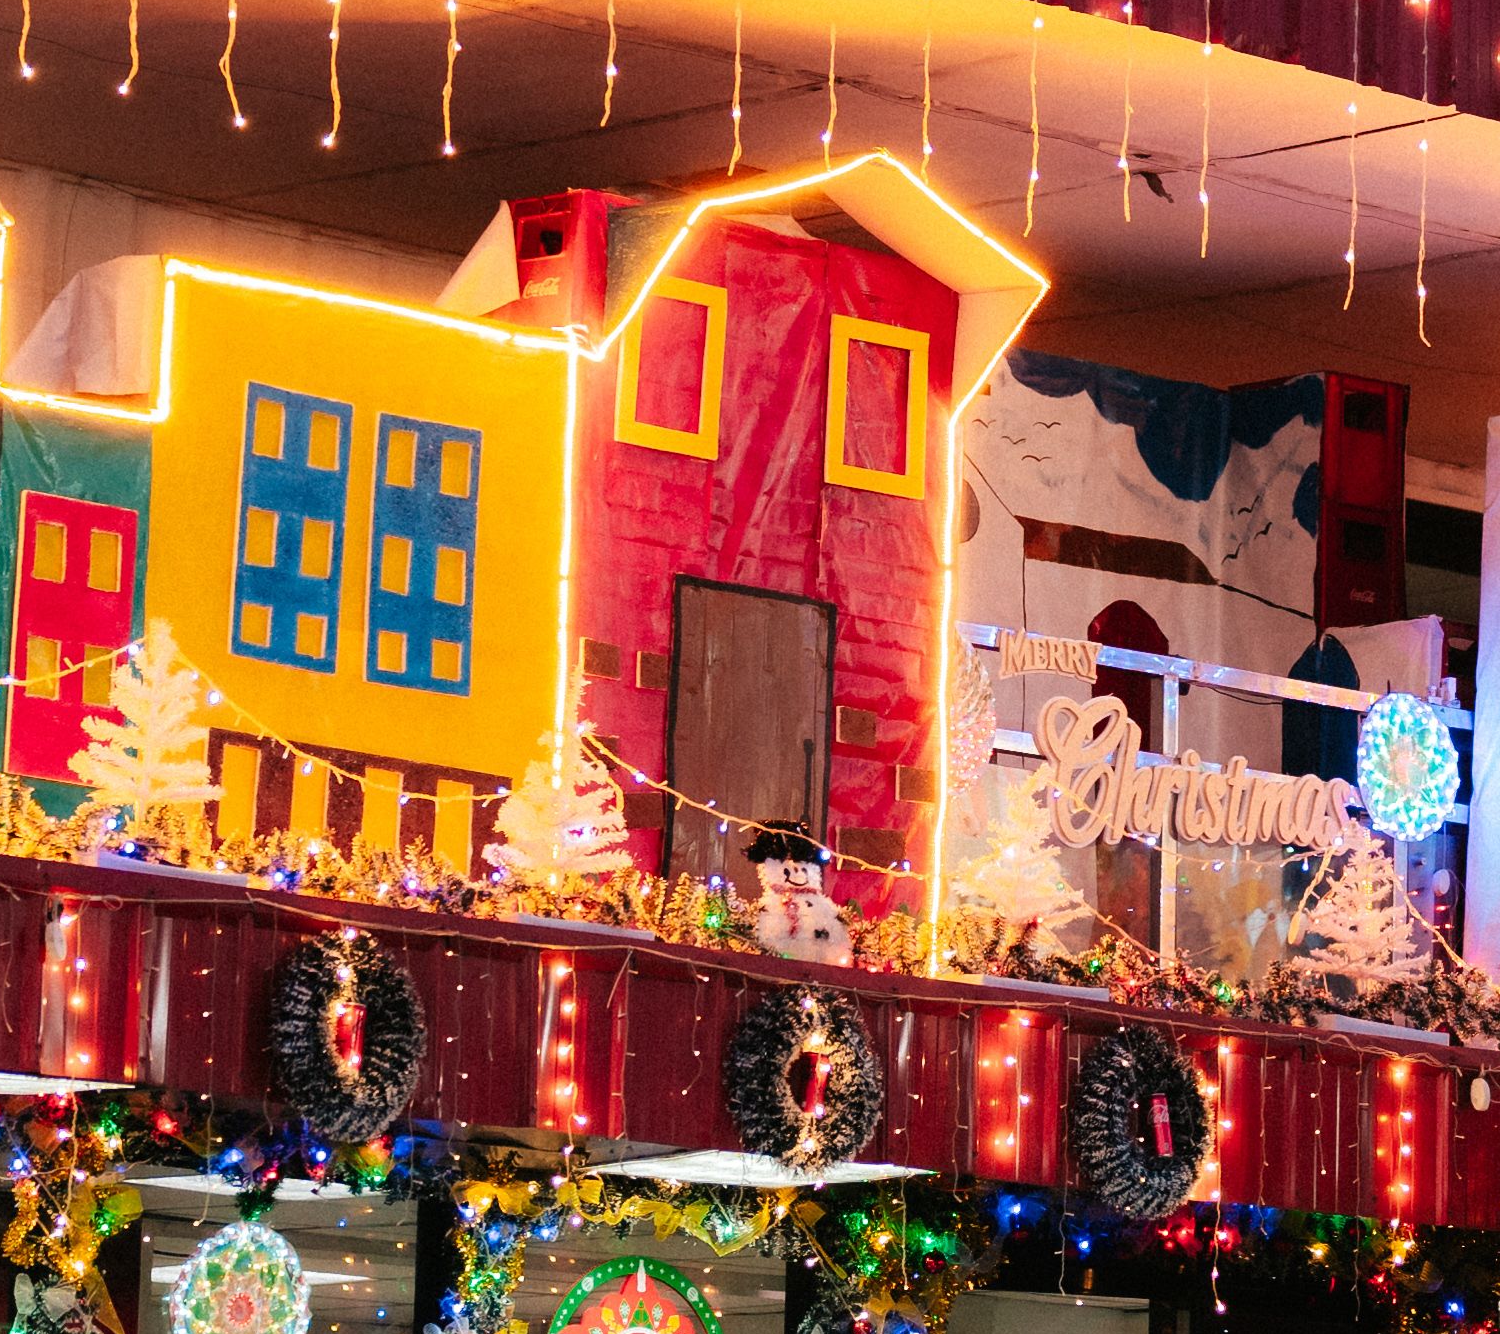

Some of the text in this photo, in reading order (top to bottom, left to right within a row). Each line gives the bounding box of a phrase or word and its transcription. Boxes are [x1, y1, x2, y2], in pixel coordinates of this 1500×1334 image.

[522, 277, 561, 299] Coca-Cola
[999, 627, 1103, 685] MERRY
[1033, 695, 1352, 854] Christmas
